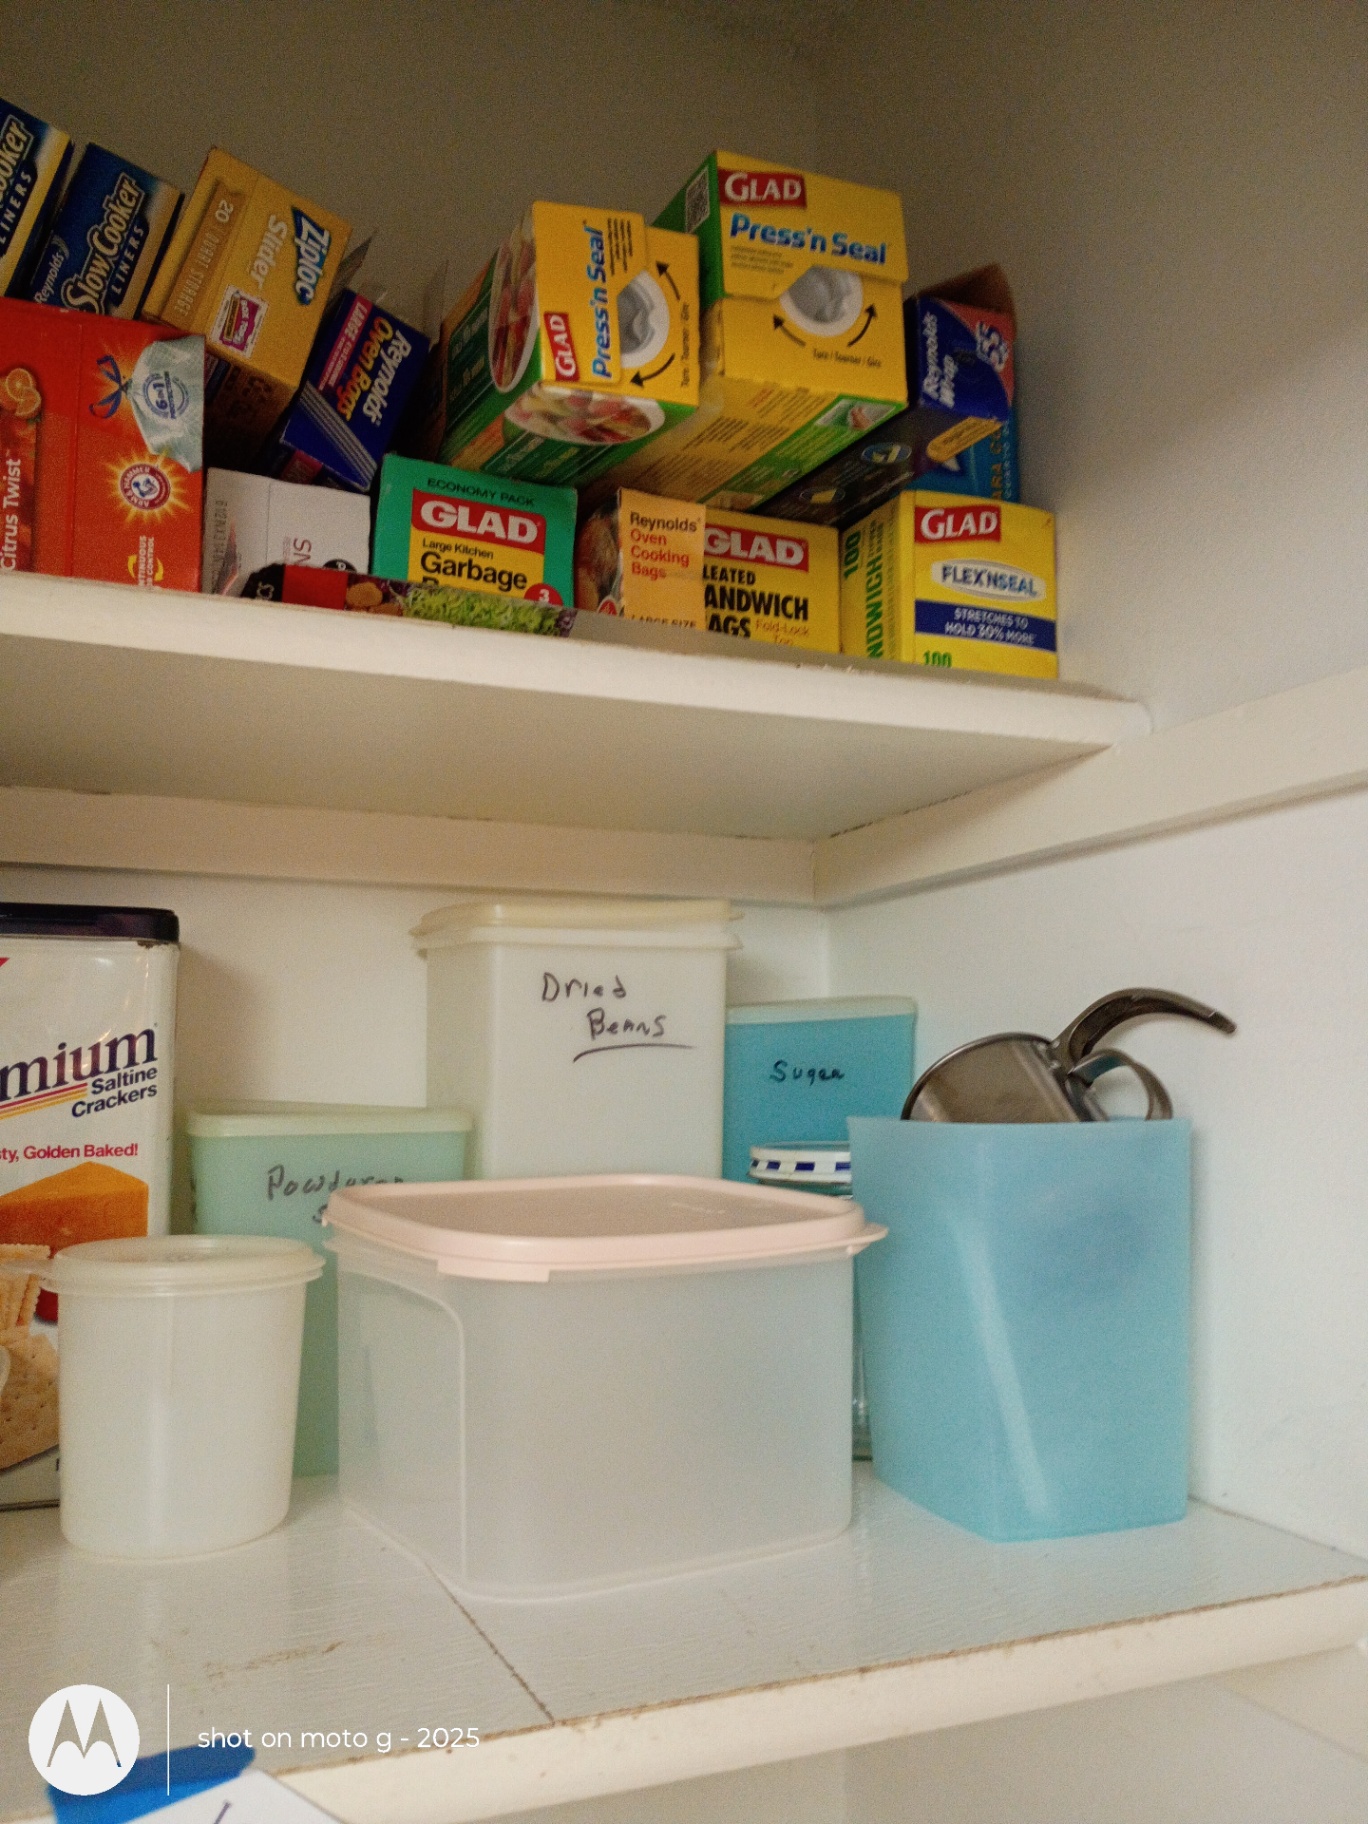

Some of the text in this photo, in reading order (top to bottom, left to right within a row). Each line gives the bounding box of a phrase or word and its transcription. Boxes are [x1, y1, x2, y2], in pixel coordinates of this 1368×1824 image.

[724, 172, 802, 201] GLAD
[214, 199, 234, 223] 20
[250, 214, 288, 286] Slider
[583, 225, 607, 284] Seal
[730, 212, 827, 253] Press'n
[831, 234, 887, 265] Seal
[111, 226, 144, 294] LINERS
[295, 217, 329, 300] Ziploc
[34, 250, 66, 304] Reynolds
[550, 316, 577, 377] GLAD
[336, 317, 393, 421] Oven Bags
[362, 330, 412, 426] Reynolds
[3, 459, 21, 508] Twist
[427, 478, 535, 508] ECONOMY PACK
[420, 500, 538, 544] GLAD
[630, 512, 697, 533] Reynolds
[630, 529, 667, 546] Oven
[920, 508, 998, 540] GLAD
[0, 515, 18, 572] Citrus
[422, 537, 494, 560] Large Kitchen
[631, 546, 690, 568] Cooking
[704, 527, 805, 566] GLAD
[843, 529, 862, 580] 100
[420, 551, 528, 592] Garbage
[632, 562, 667, 580] Bags
[703, 564, 756, 586] LEATED
[704, 587, 809, 622] ANDWICH
[865, 553, 884, 659] NDWICH
[954, 606, 1029, 631] STRETCHES TO
[708, 613, 751, 637] AGS
[944, 621, 976, 638] HOLD
[1006, 630, 1037, 647] MORE
[541, 972, 627, 1001] Dried
[587, 1007, 666, 1040] Beans
[0, 1028, 157, 1101] mium
[91, 1065, 157, 1095] Saltine
[72, 1084, 157, 1118] Crackers
[0, 1143, 138, 1163] ty, Golden Baked!
